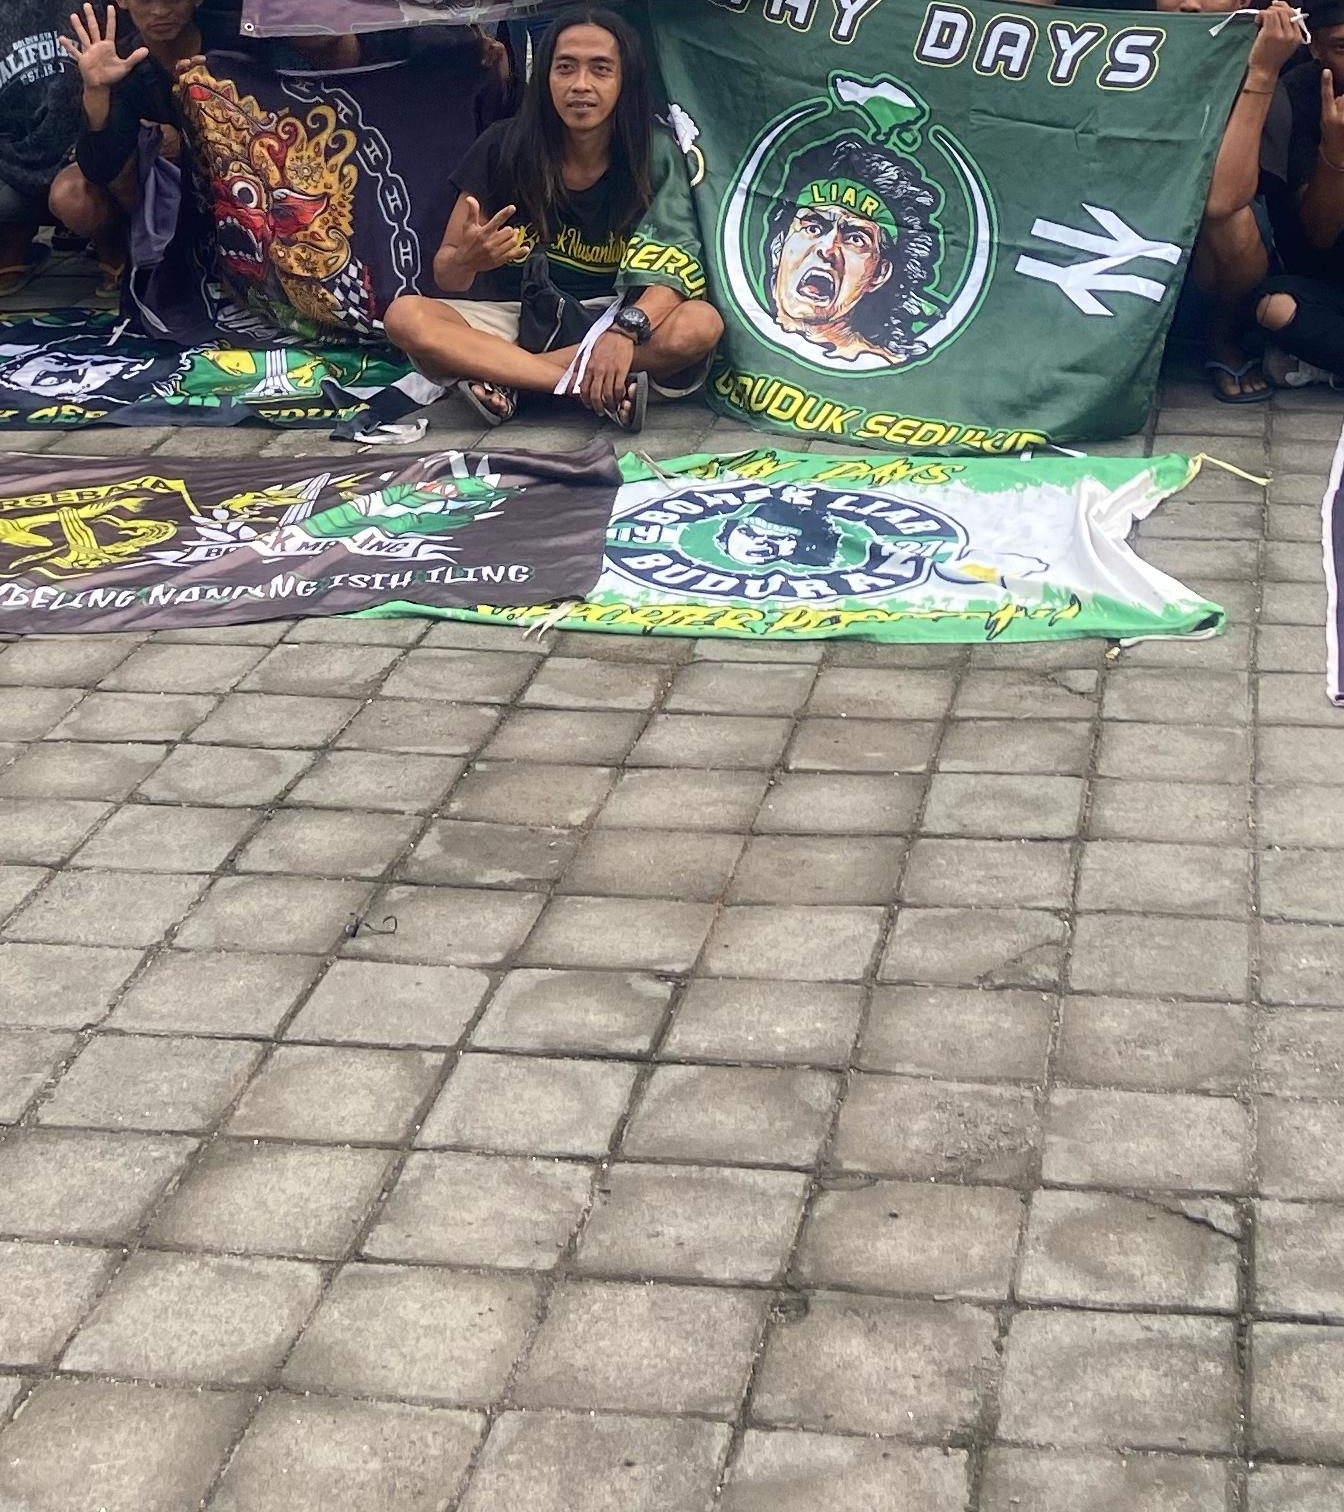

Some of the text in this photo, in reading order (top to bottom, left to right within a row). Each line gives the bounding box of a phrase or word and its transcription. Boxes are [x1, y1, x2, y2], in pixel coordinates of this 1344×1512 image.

[914, 1, 1167, 91] DAYS
[811, 181, 882, 219] LIAR
[328, 570, 412, 590] ISIH
[424, 564, 531, 585] ILING
